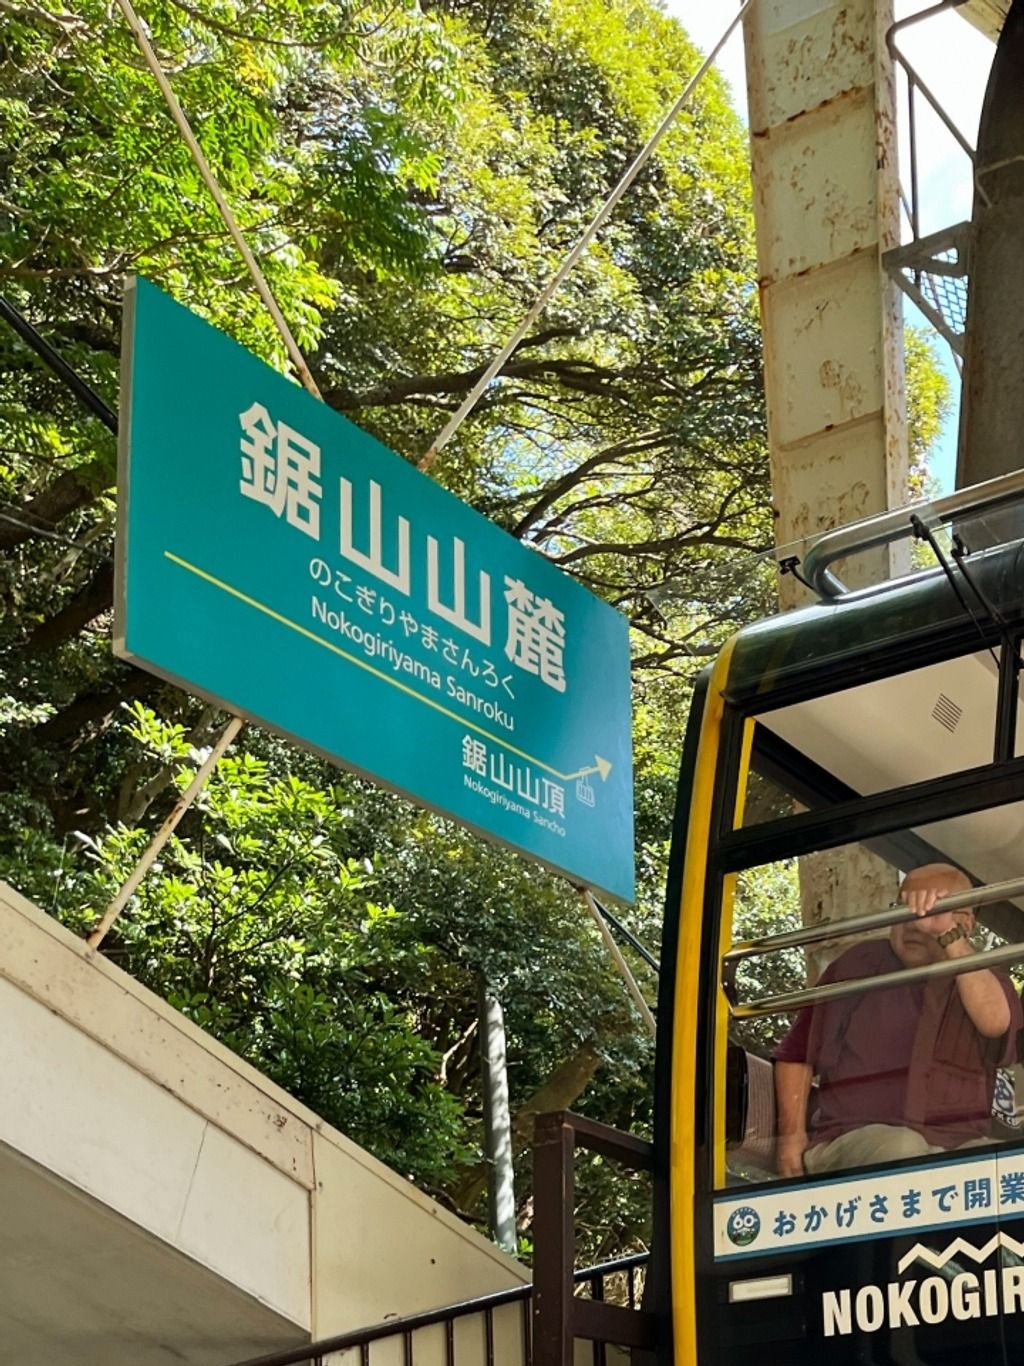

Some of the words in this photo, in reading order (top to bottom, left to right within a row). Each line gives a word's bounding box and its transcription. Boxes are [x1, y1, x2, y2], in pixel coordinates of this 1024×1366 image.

[238, 401, 567, 693] 鋸山山麓
[308, 557, 516, 700] のこぎりやまさんろく
[310, 596, 442, 691] Nokogiriyama
[446, 669, 514, 731] Sanroku
[462, 734, 565, 819] 鋸山山頂
[463, 775, 531, 819] Nokogiriyama
[533, 810, 566, 838] Sancho
[733, 1214, 755, 1230] 60
